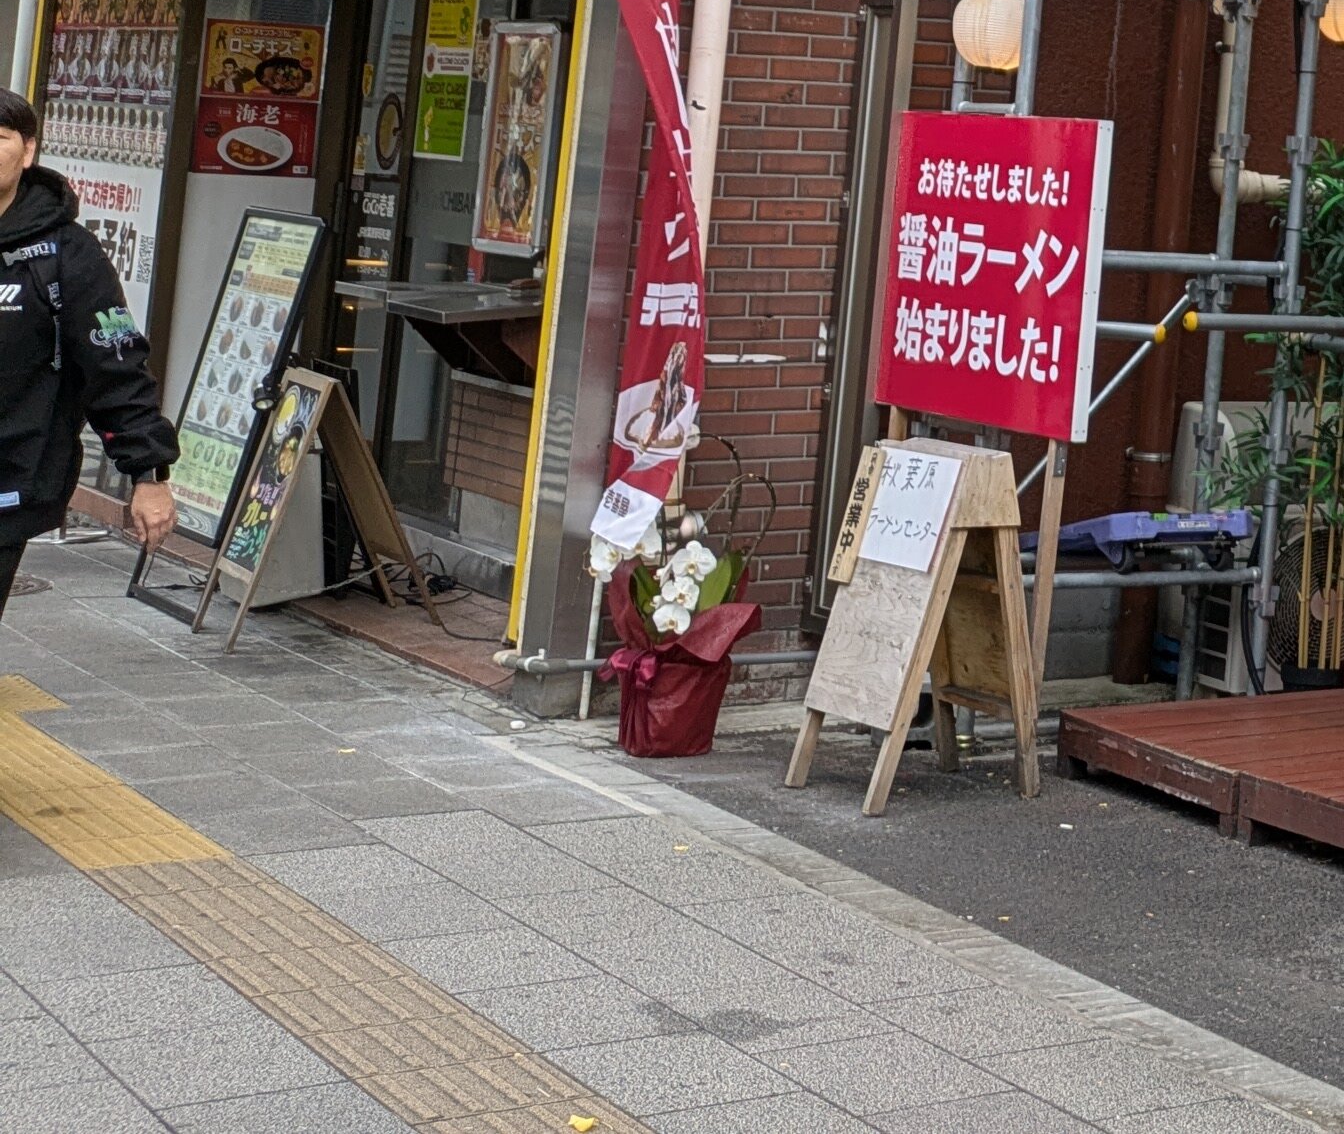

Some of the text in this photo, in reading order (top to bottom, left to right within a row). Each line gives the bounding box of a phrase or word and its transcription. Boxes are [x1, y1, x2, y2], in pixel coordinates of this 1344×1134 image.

[235, 103, 281, 125] 海老
[917, 158, 1070, 206] お待たせしました!
[897, 212, 1080, 298] 醤油ラーメン
[893, 296, 1063, 383] 始まりました!
[881, 457, 939, 491] 秋葉原
[867, 507, 938, 541] ラーメンセンター
